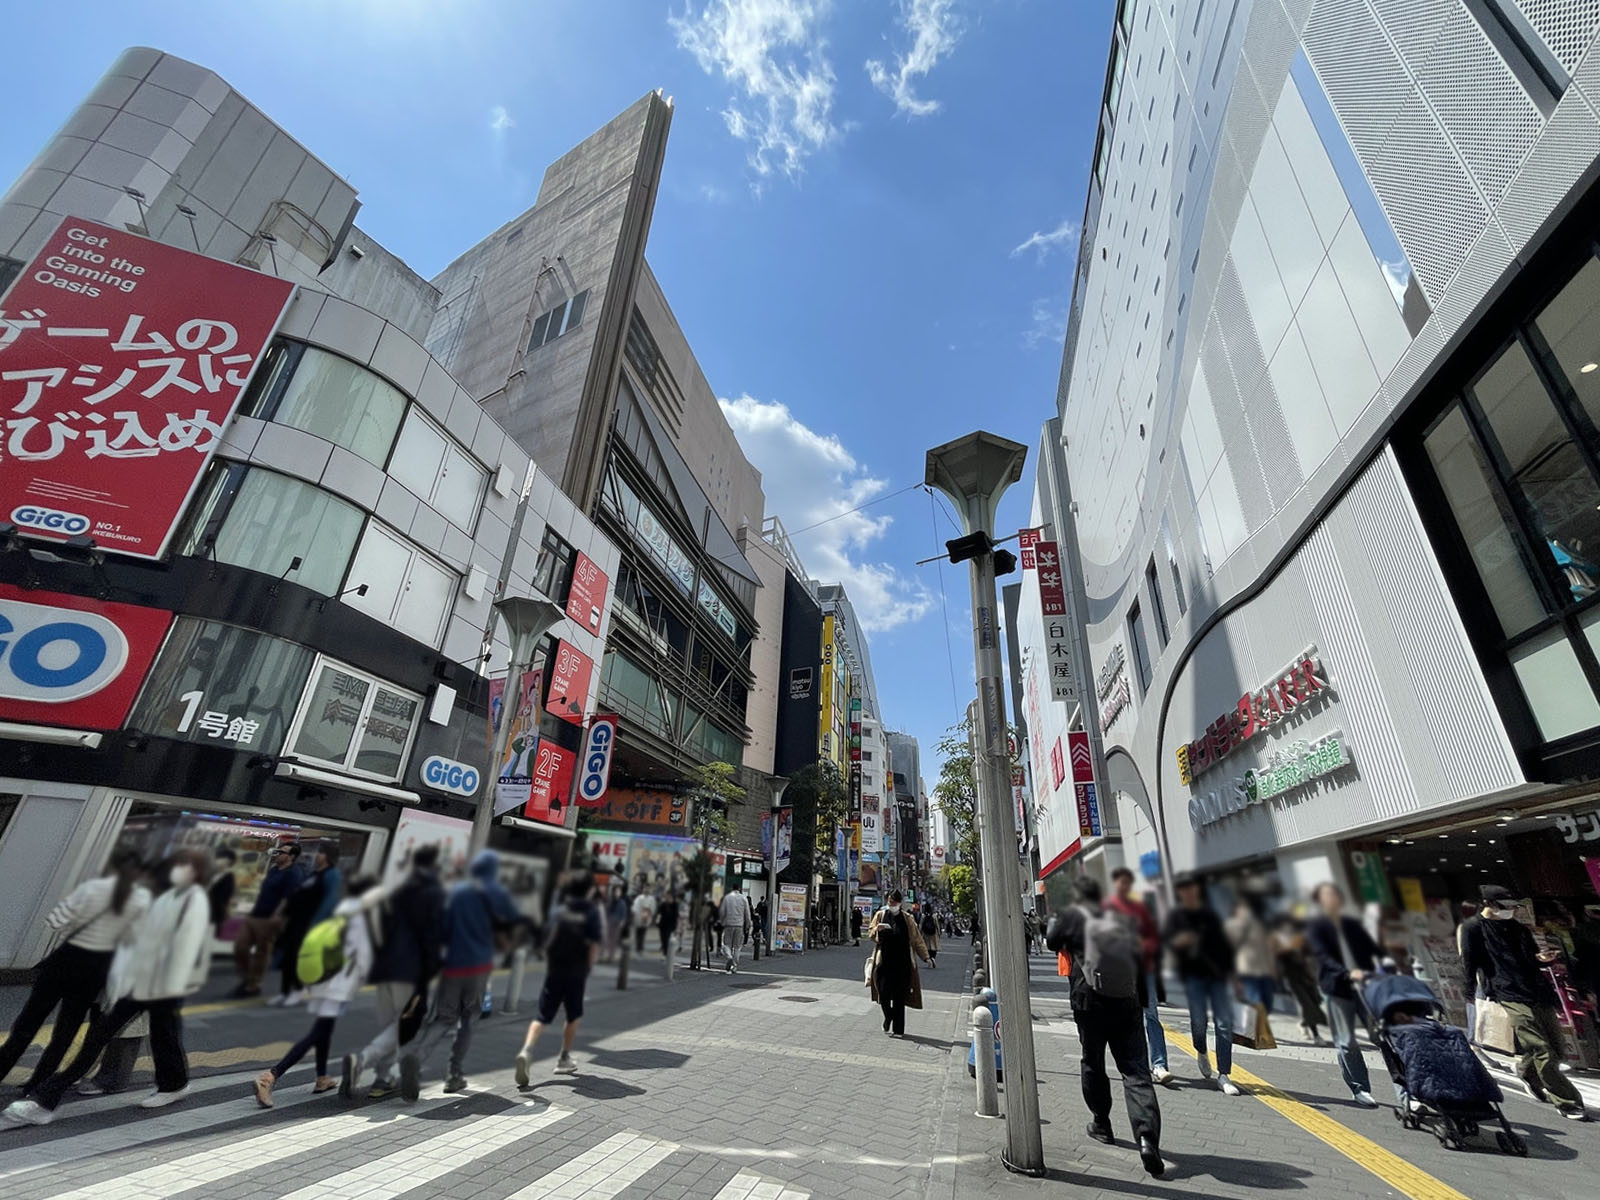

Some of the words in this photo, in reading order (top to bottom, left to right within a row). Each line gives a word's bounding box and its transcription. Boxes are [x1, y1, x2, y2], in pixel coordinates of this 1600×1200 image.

[66, 227, 109, 249] Get
[45, 256, 137, 293] Gaming
[62, 243, 105, 265] into
[110, 255, 146, 277] the
[34, 270, 102, 298] Oasis
[0, 308, 239, 354] ゲームの
[1, 353, 253, 414] アシスに
[0, 409, 222, 462] び込め
[14, 506, 87, 534] GiGO
[96, 521, 121, 532] NO.1
[91, 529, 141, 544] IKEBUKURO
[576, 558, 598, 587] 4F
[0, 613, 107, 688] O
[557, 648, 581, 678] 3F
[1049, 622, 1071, 679] 白木屋
[553, 682, 567, 696] GAME
[555, 675, 569, 689] CRANE
[177, 690, 260, 744] 1号館
[536, 747, 563, 778] 2F
[583, 723, 612, 797] GiGO
[425, 761, 478, 793] GiGO
[532, 784, 547, 797] GAME
[533, 776, 550, 789] CRANE
[671, 812, 682, 821] 3F
[1087, 785, 1100, 834] 処方せん受付
[1555, 811, 1600, 844] サン
